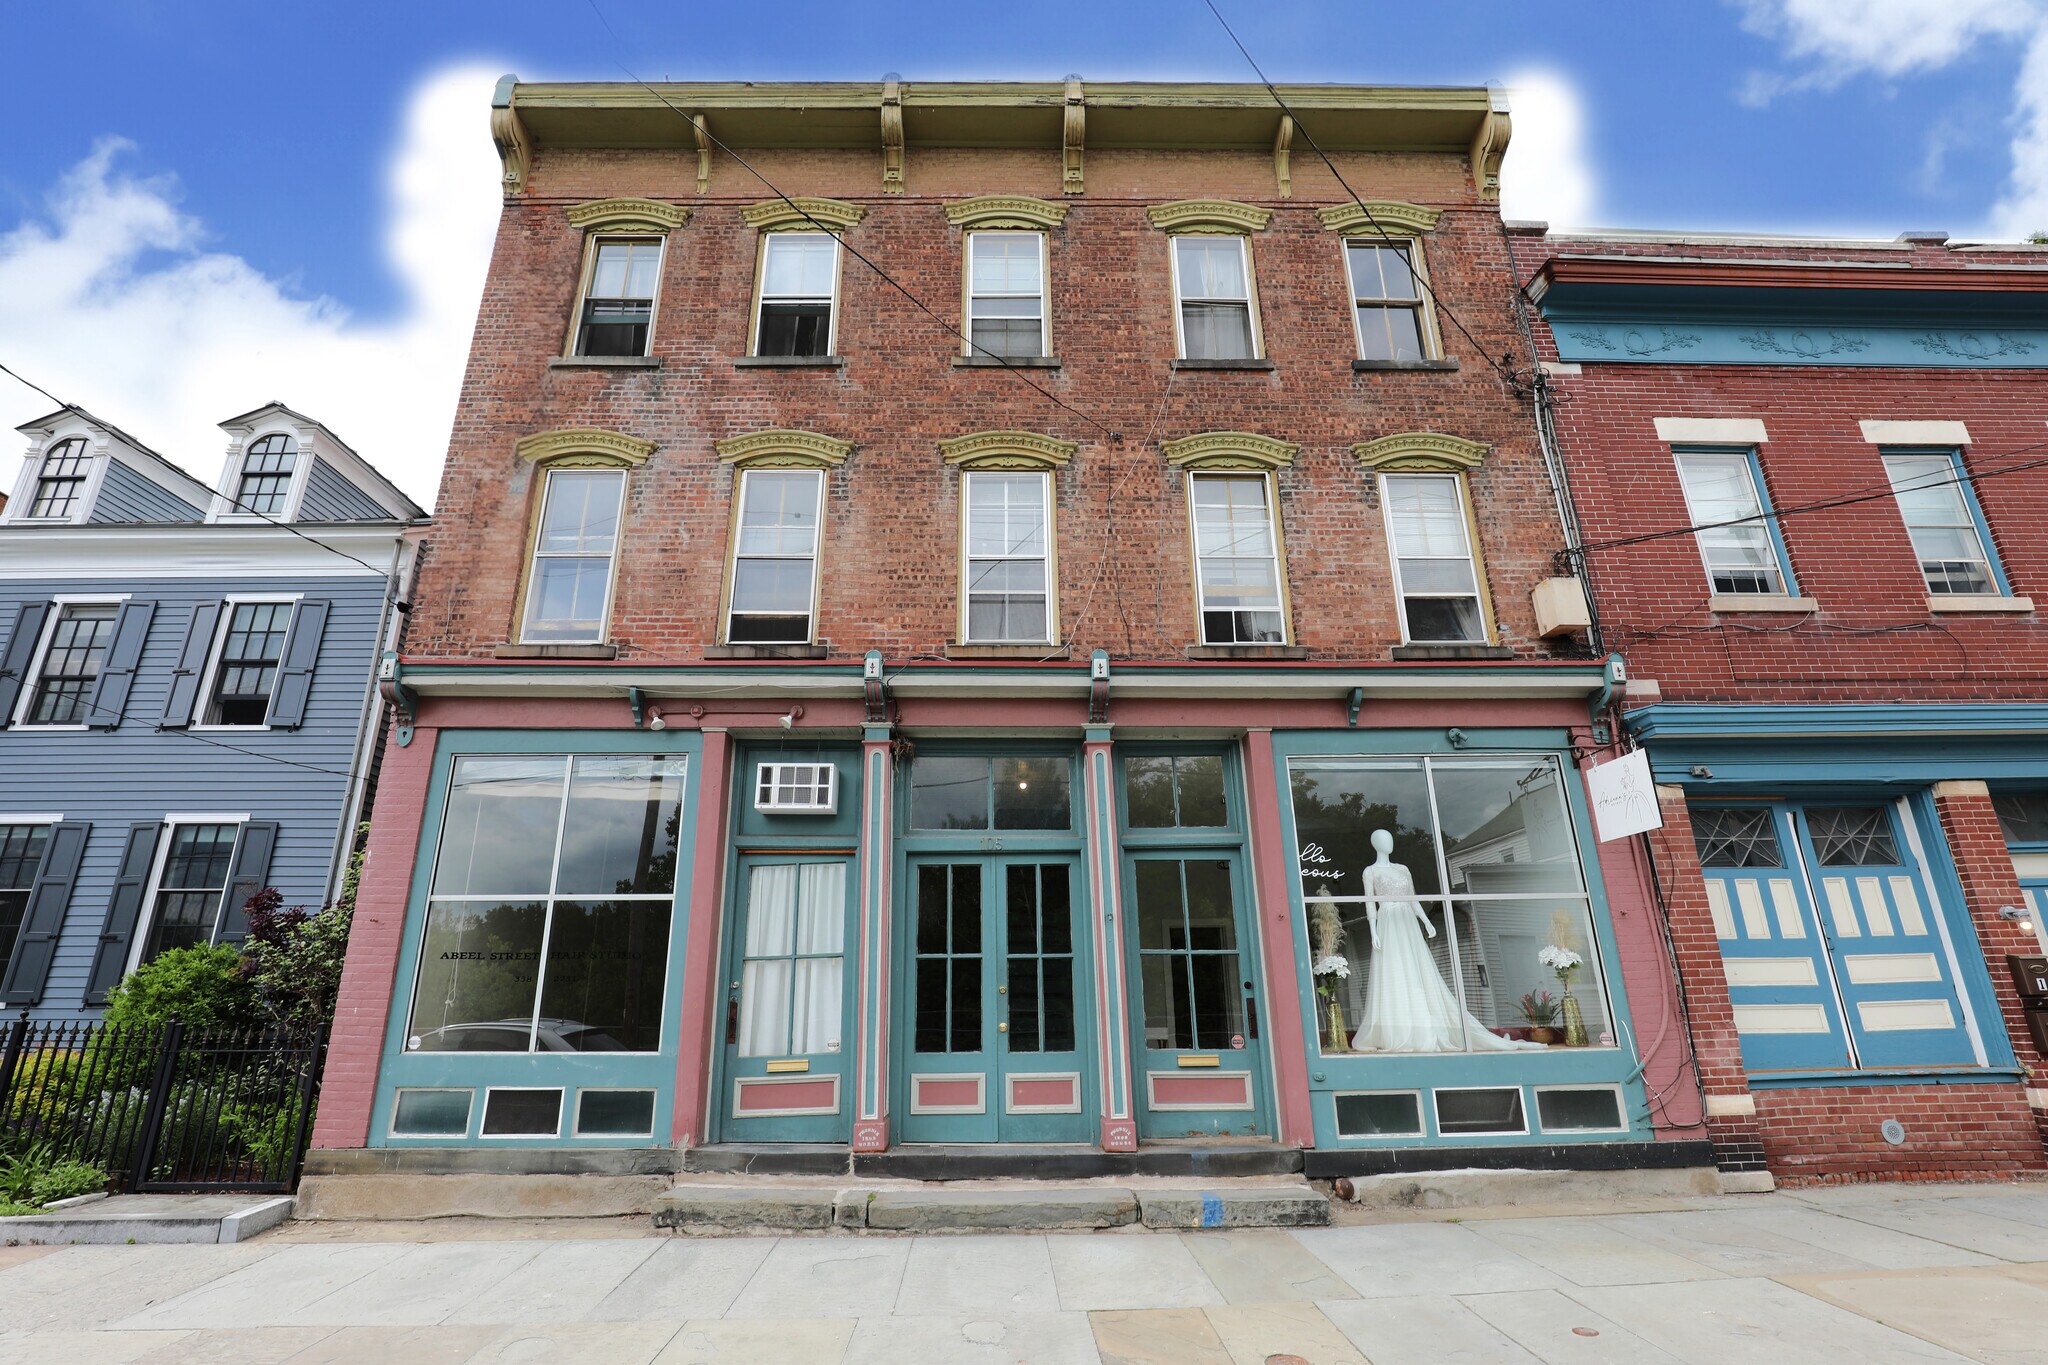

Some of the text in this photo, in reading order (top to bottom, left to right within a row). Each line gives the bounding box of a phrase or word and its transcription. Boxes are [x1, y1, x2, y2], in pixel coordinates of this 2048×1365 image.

[980, 837, 1003, 851] 105
[440, 951, 642, 961] ABEEL STREET HAIR STUDIO
[2039, 979, 2046, 990] 1
